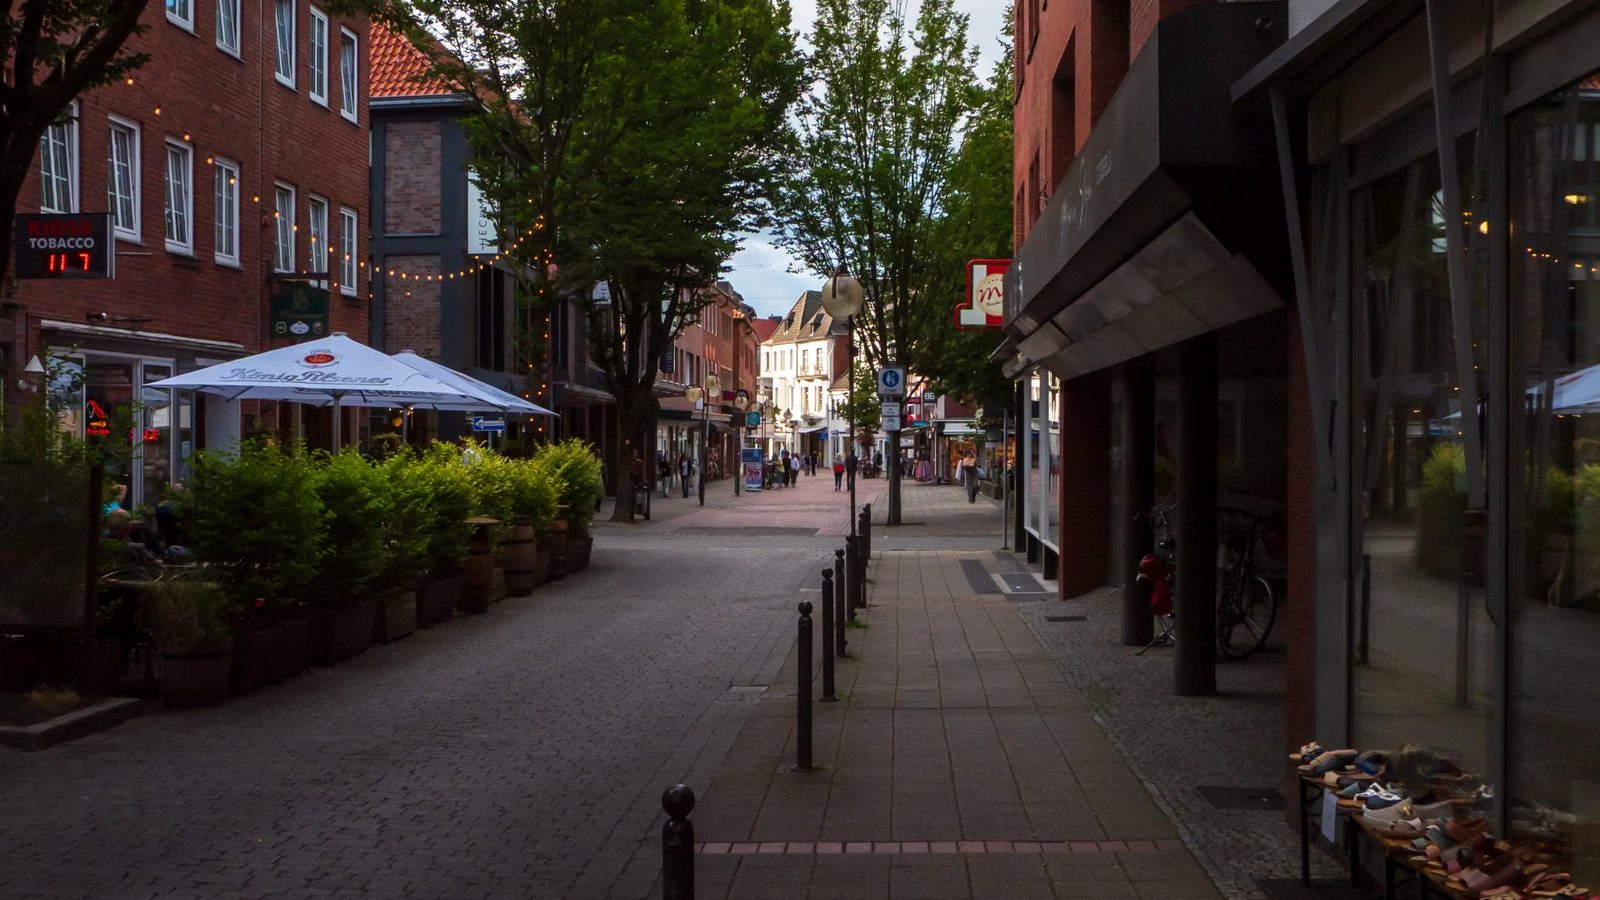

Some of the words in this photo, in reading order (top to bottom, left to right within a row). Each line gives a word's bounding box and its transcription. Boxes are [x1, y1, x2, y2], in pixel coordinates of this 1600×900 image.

[29, 237, 95, 249] TOBACCO
[219, 368, 295, 383] König
[296, 370, 393, 384] Pilsener
